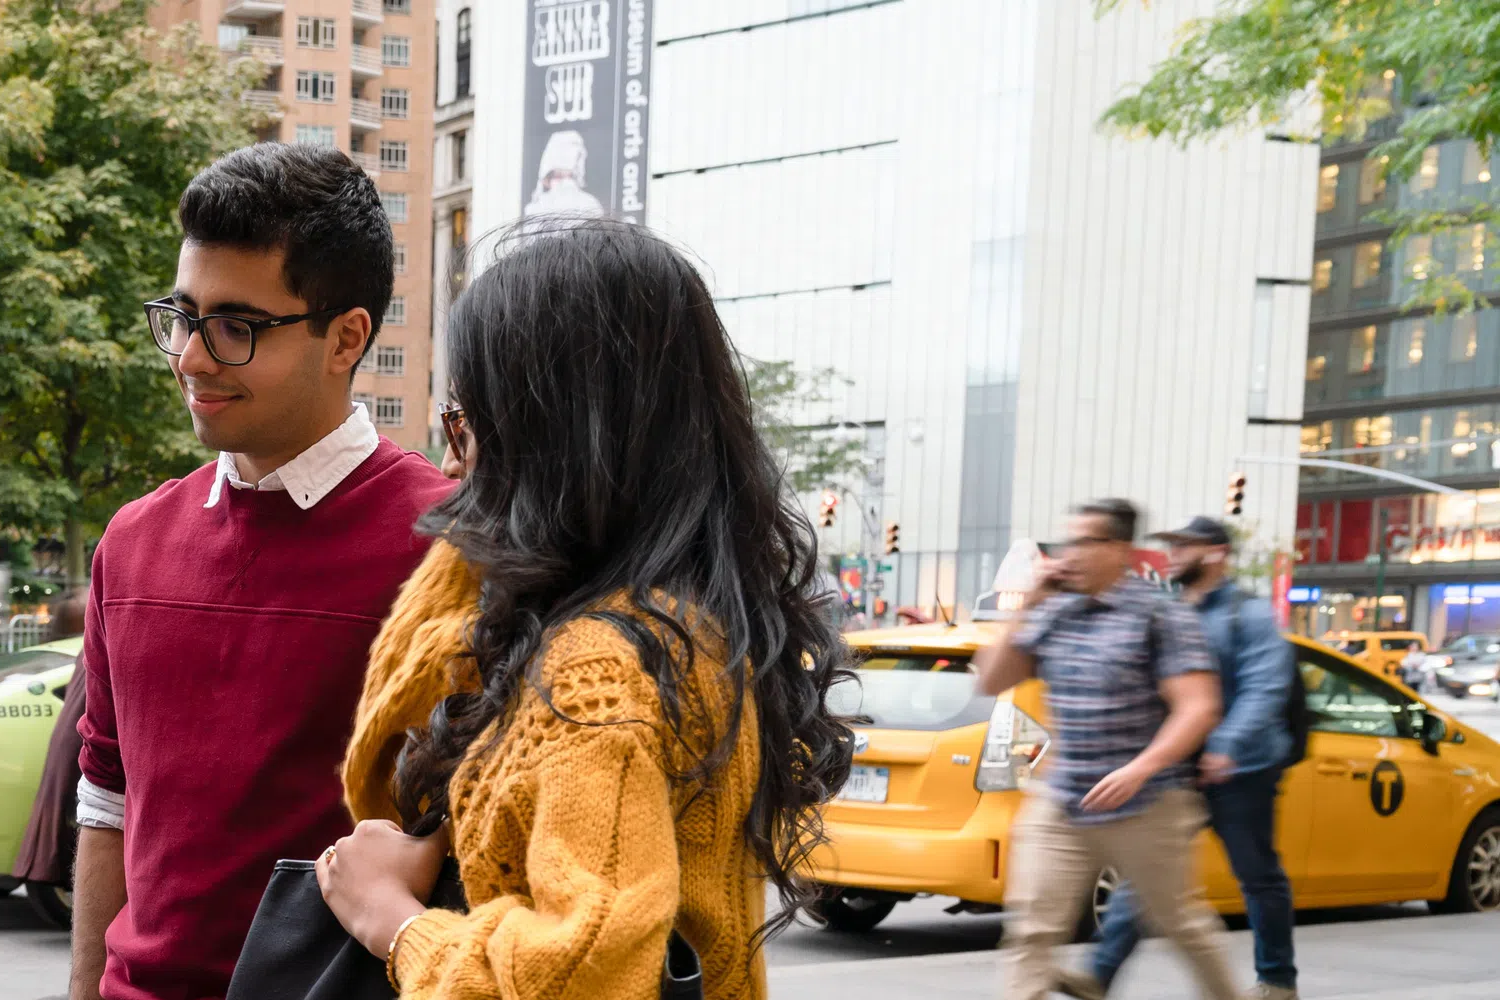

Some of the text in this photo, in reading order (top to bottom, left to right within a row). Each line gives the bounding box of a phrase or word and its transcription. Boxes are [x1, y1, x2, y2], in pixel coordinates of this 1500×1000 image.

[625, 0, 645, 76] useum
[623, 79, 648, 107] of
[623, 109, 644, 159] arts
[621, 162, 644, 212] and
[1377, 770, 1398, 810] T
